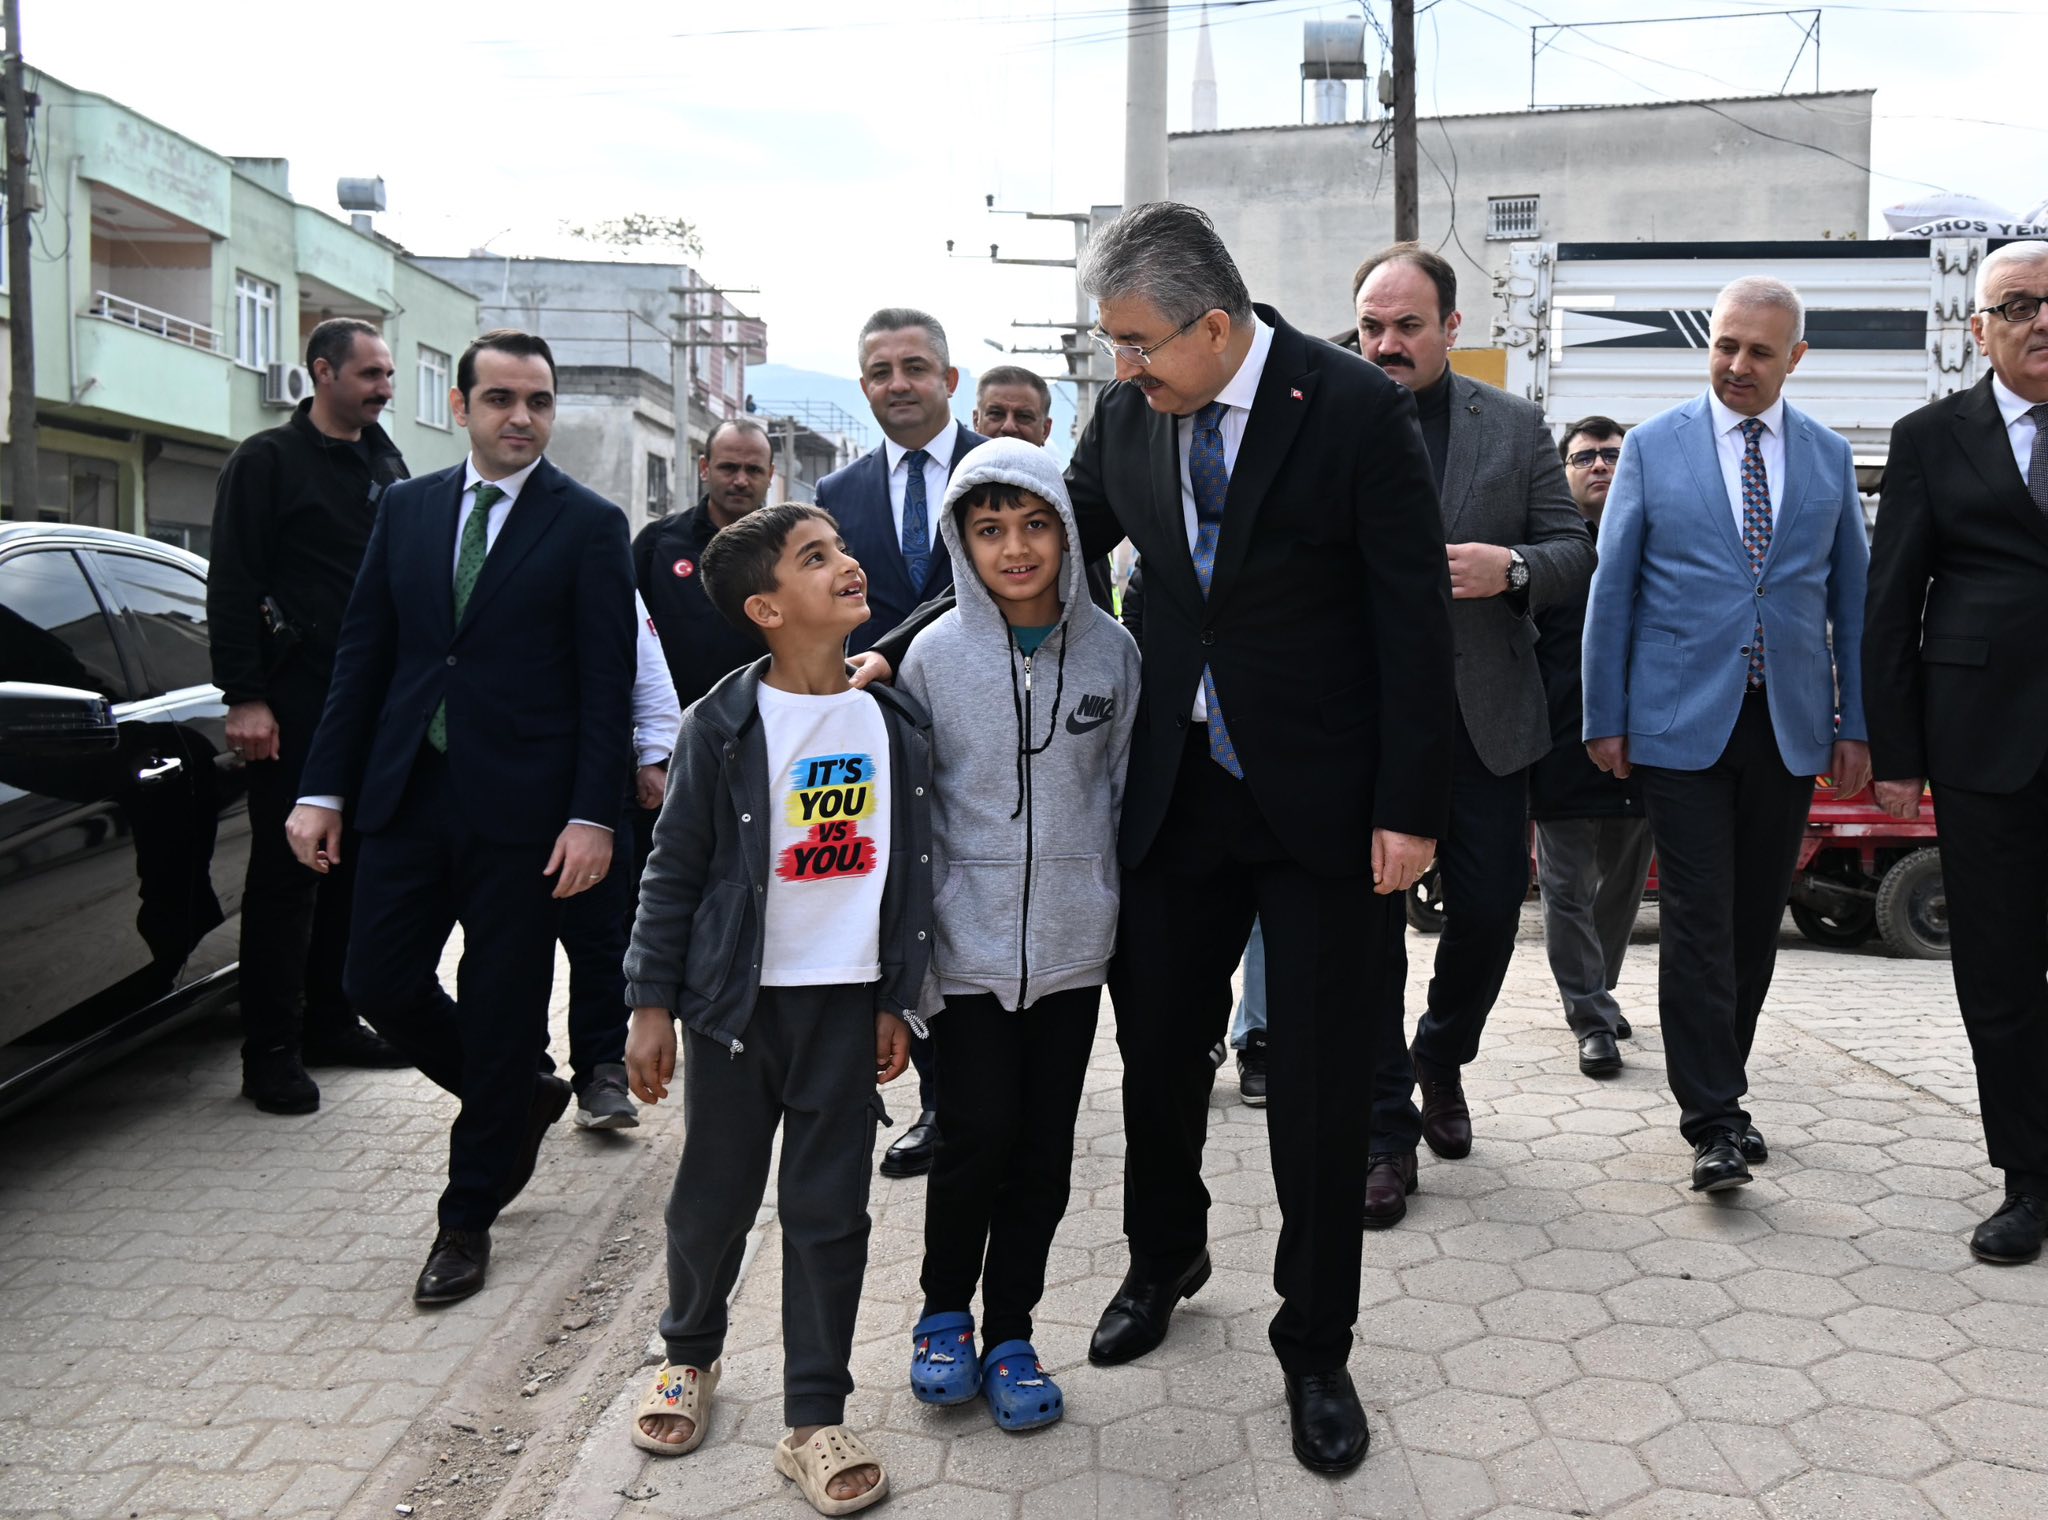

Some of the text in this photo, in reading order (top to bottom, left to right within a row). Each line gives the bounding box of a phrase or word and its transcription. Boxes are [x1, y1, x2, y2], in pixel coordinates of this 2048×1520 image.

[807, 757, 863, 787] IT'S
[799, 787, 866, 821] YOU
[819, 821, 848, 842] VS
[794, 842, 865, 876] YOU.
